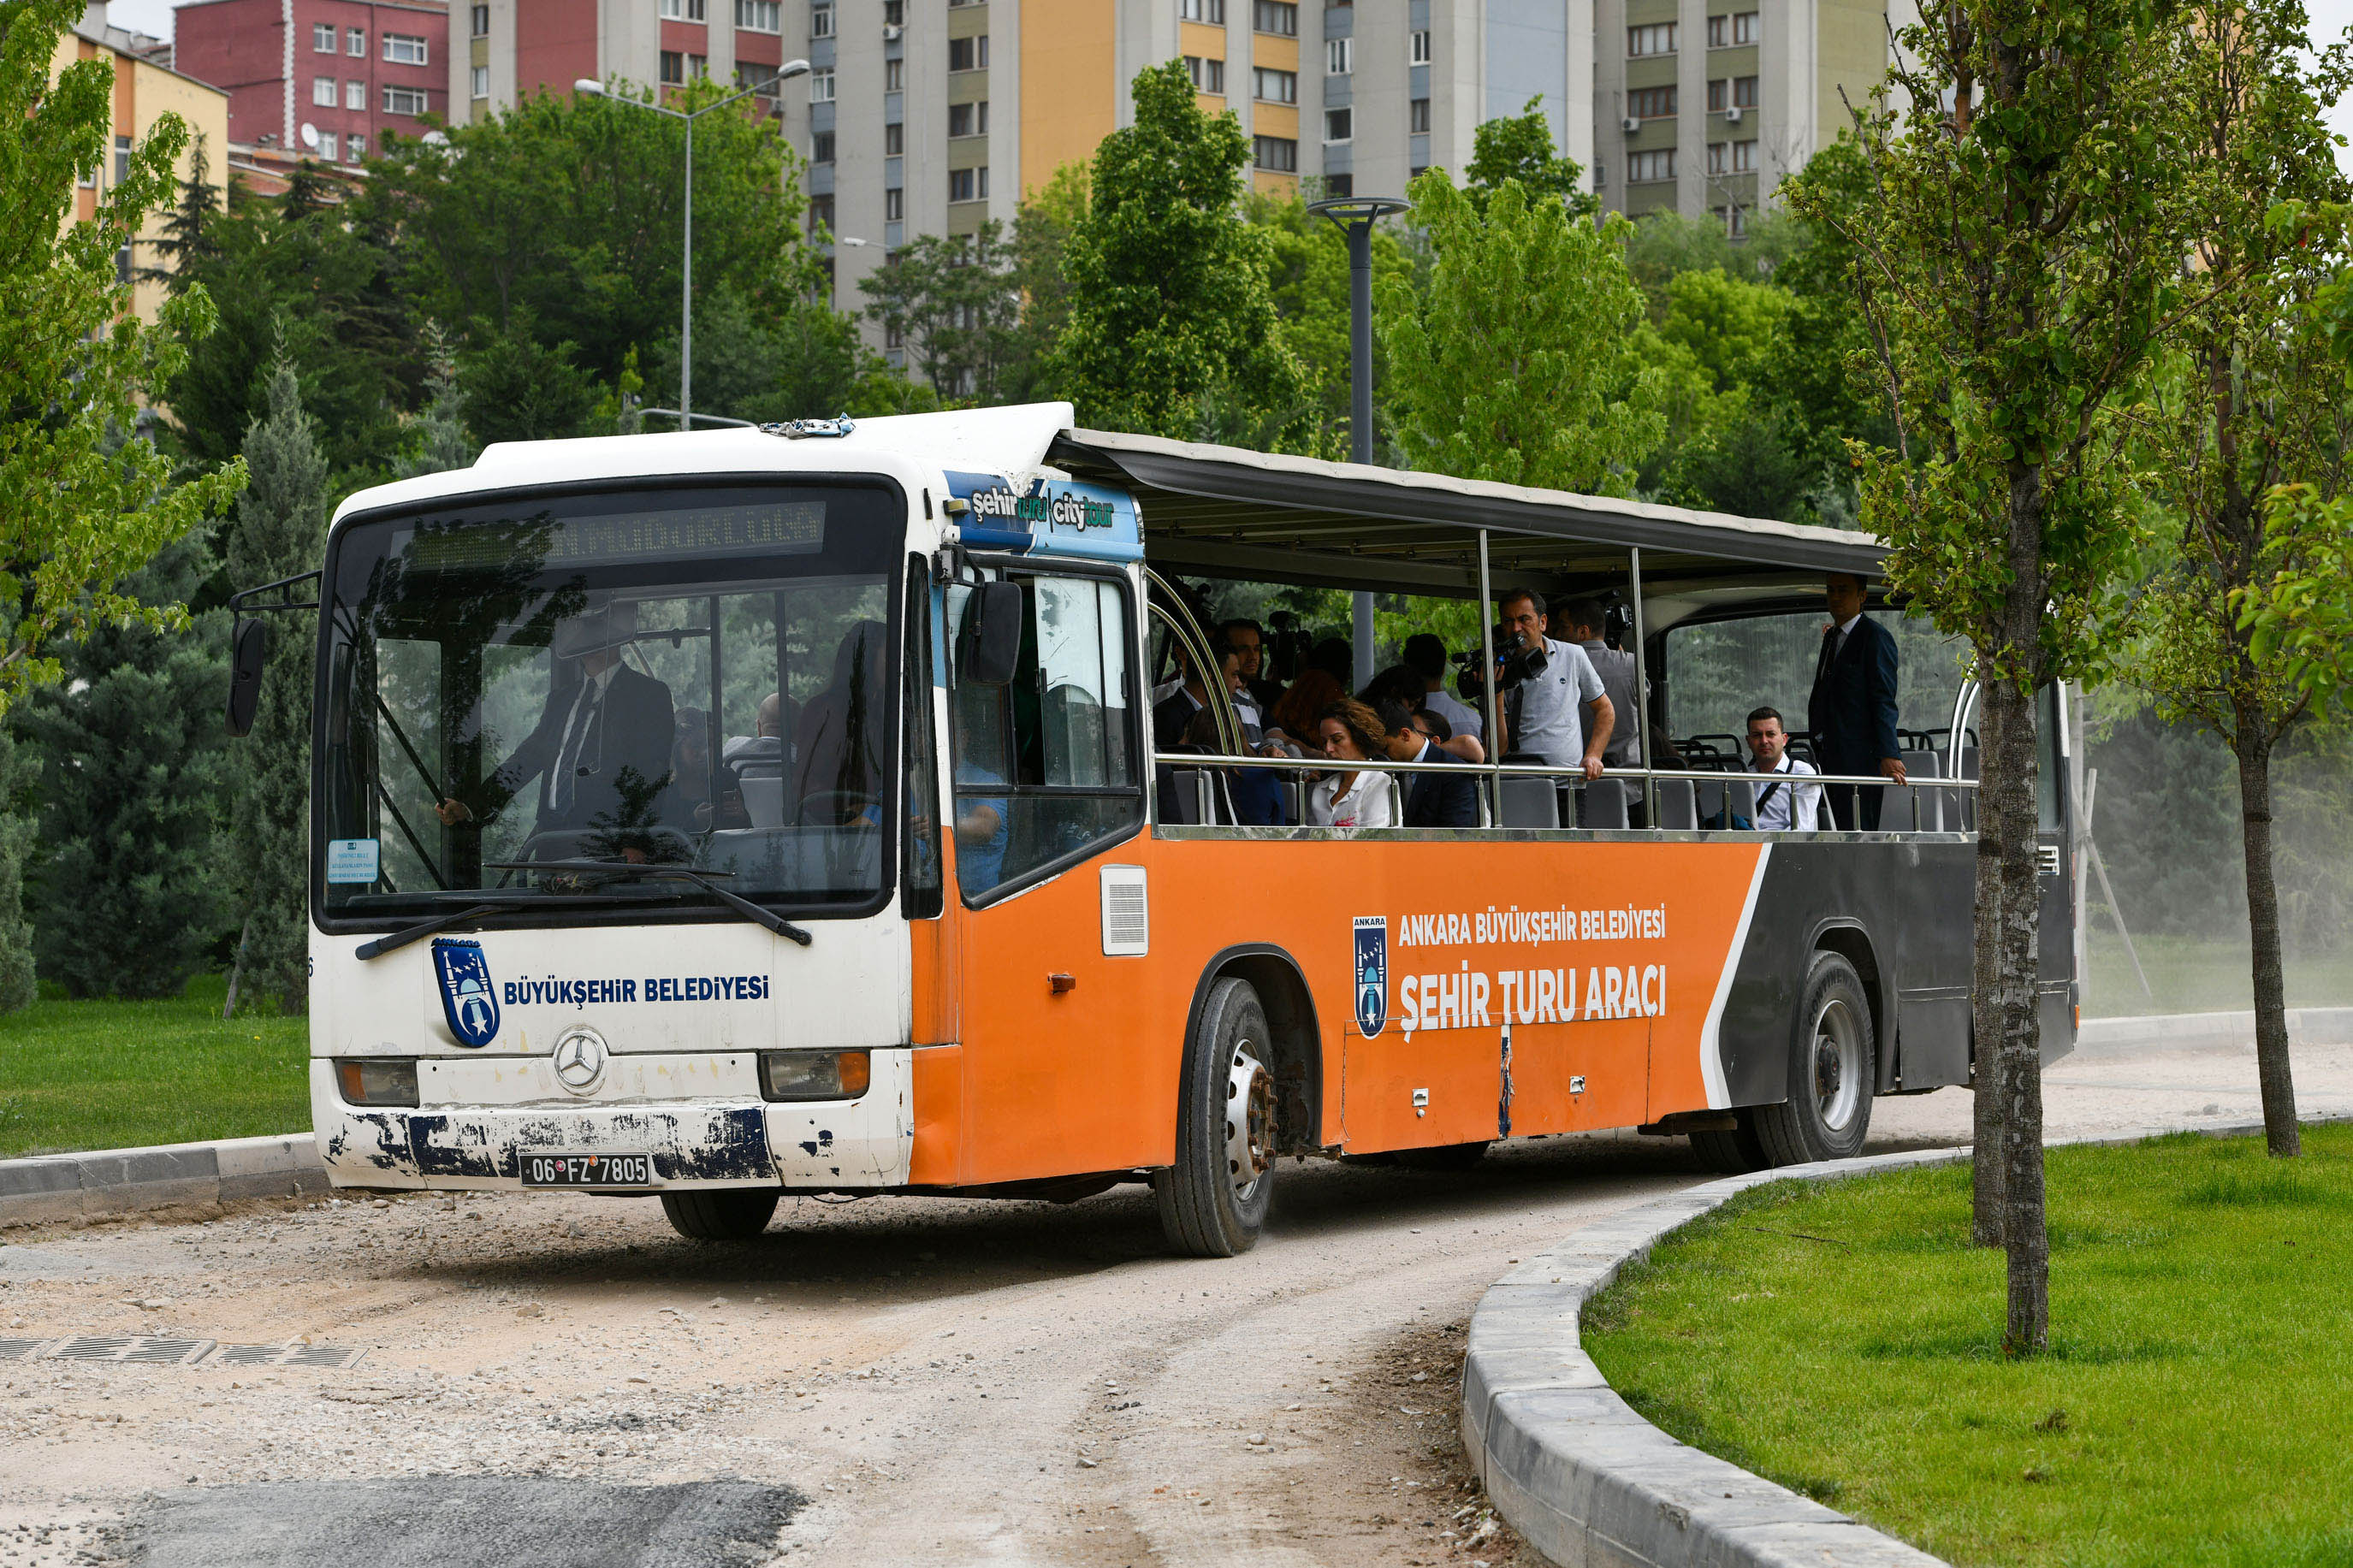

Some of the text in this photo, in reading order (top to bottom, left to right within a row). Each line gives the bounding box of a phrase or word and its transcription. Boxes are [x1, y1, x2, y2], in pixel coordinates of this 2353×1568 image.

[1399, 902, 1665, 947] ANKARA BÜYÜKŞEHİR BELEDİYESİ
[504, 975, 768, 1009] BÜYÜKŞEHİR BELEDİYESİ
[1400, 960, 1665, 1043] ŞEHİR TURU ARACI
[532, 1158, 646, 1182] 06 FZ 7805
